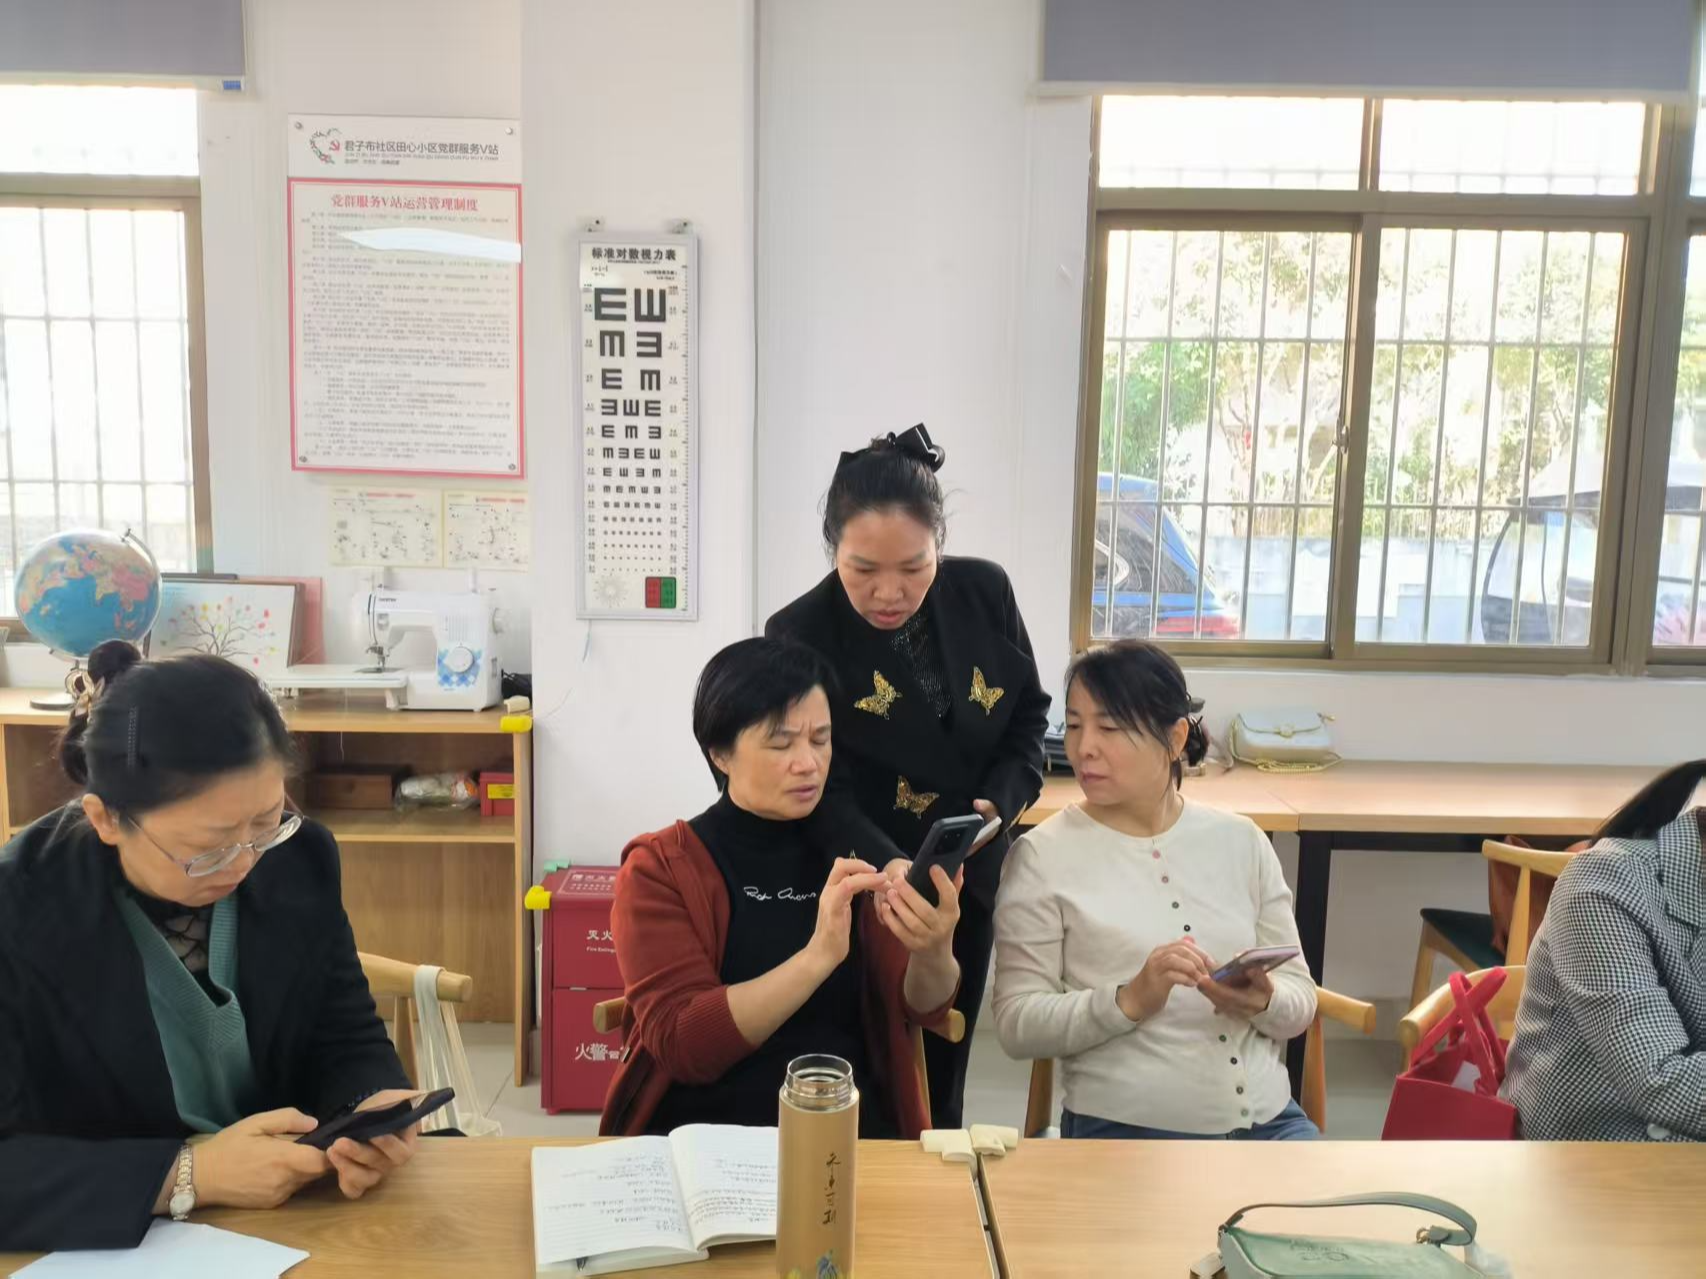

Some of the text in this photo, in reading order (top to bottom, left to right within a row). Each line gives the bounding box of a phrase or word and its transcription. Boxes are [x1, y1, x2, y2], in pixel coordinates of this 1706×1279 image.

[344, 140, 499, 156] 君子布社区田心小区党群服务V站
[331, 194, 479, 212] 党群服务V站运营管理制度
[592, 247, 676, 261] 标准对数视力表
[575, 1042, 609, 1061] 火警
